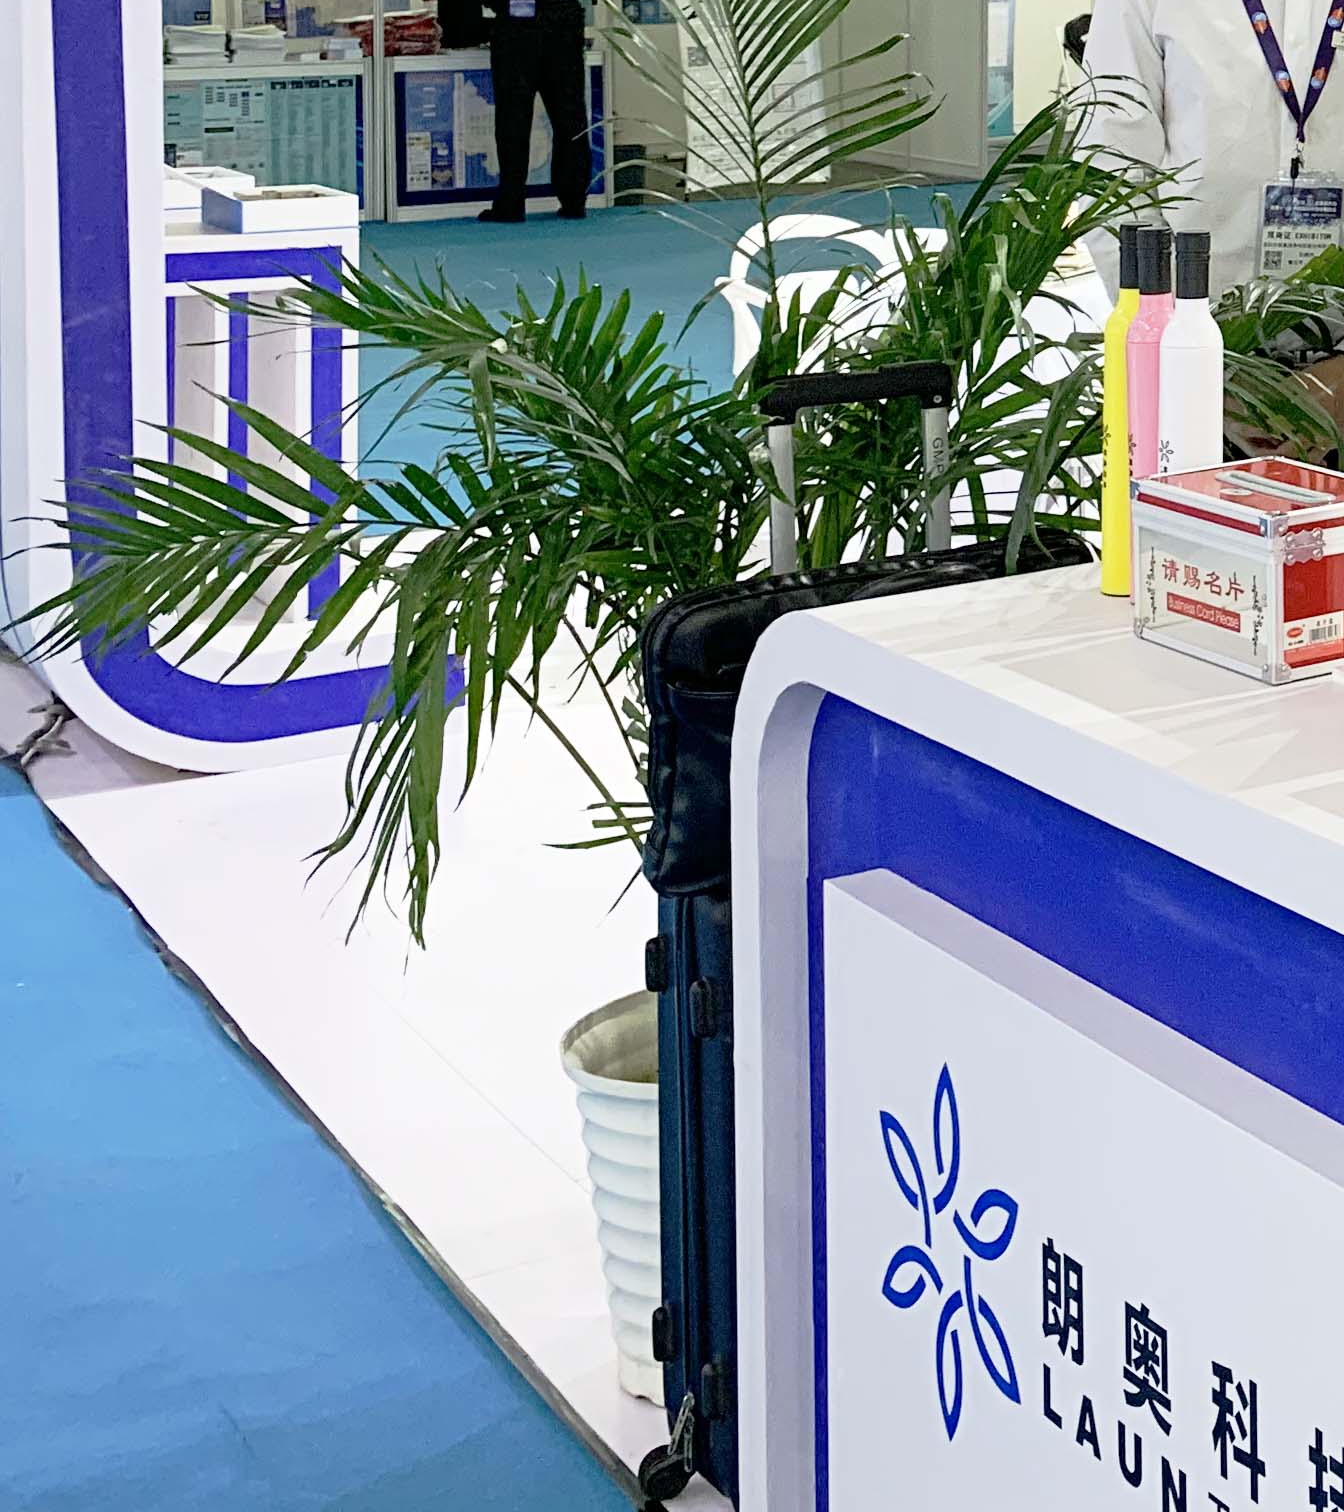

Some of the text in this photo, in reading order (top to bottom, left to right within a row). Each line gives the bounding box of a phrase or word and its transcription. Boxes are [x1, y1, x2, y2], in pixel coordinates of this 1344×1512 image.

[1162, 558, 1245, 602] 请赐名片
[1197, 604, 1215, 621] Card
[1215, 609, 1239, 629] Please
